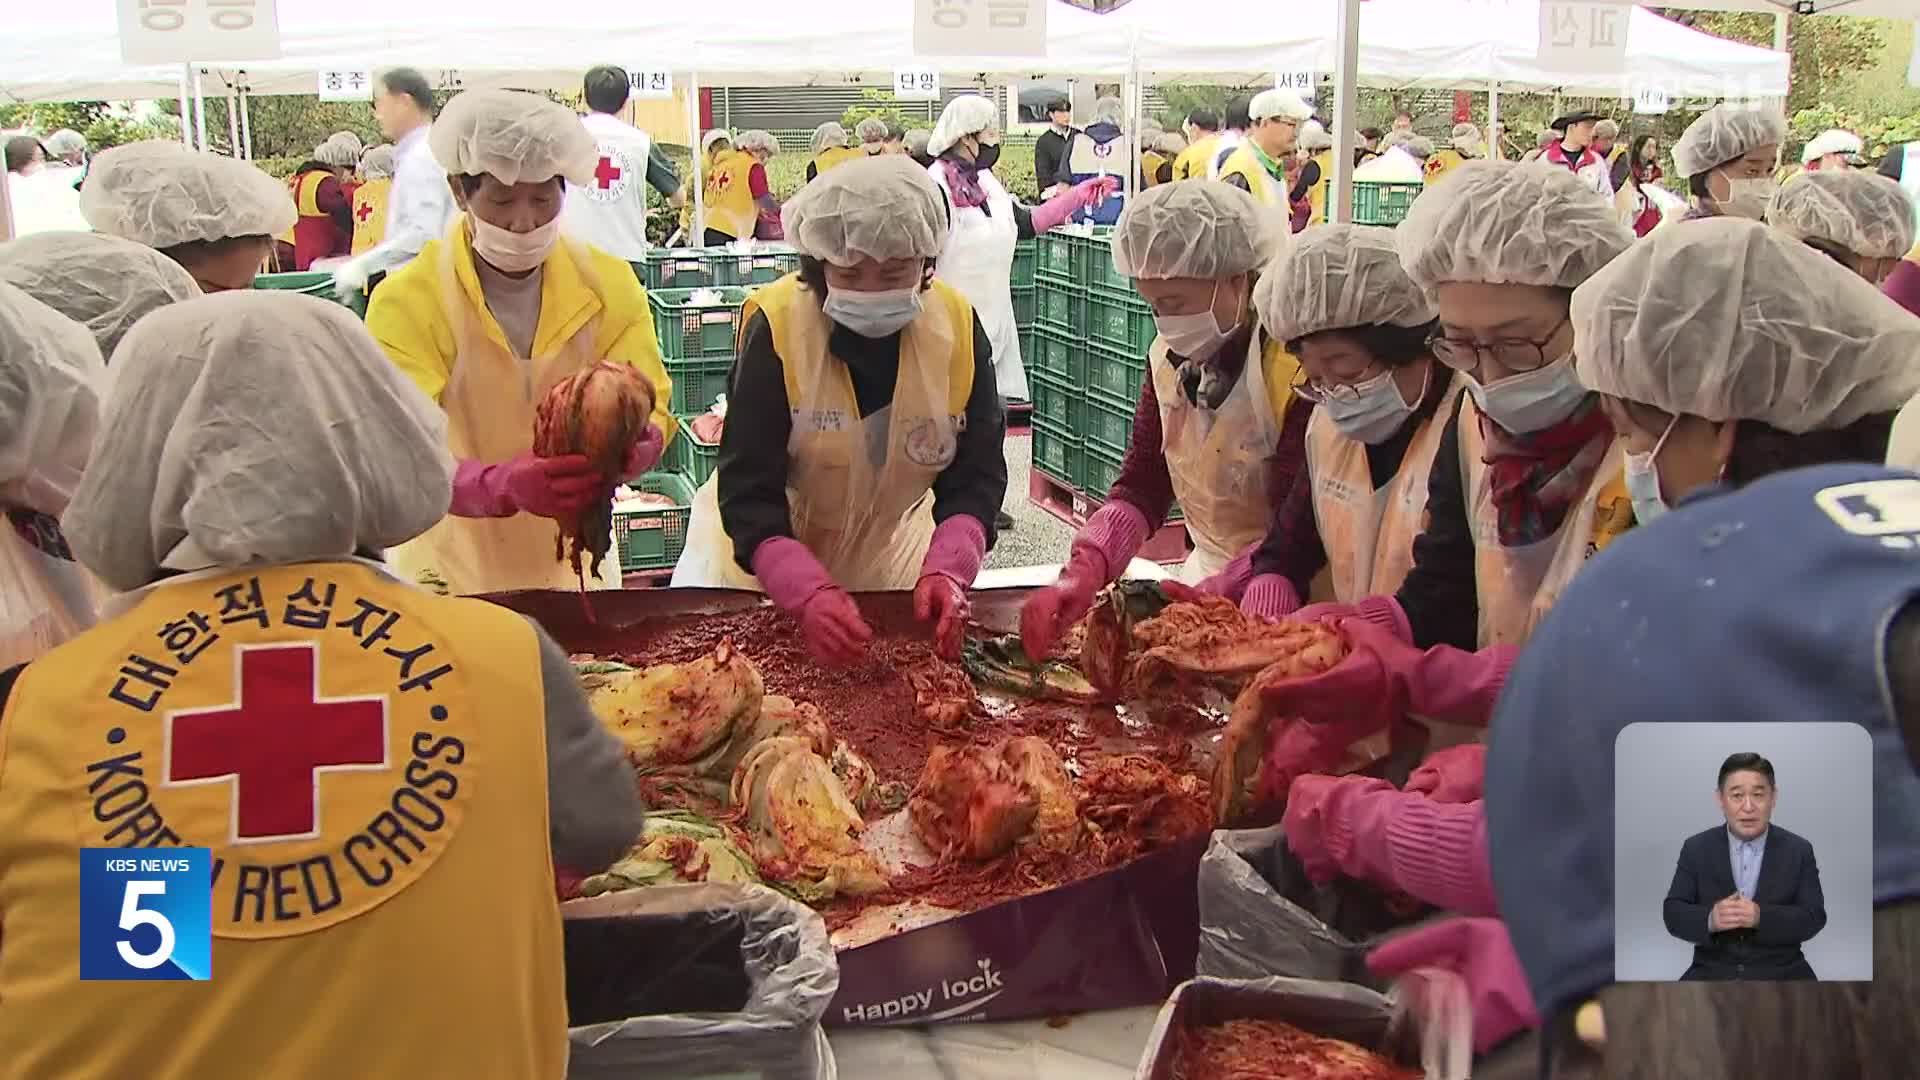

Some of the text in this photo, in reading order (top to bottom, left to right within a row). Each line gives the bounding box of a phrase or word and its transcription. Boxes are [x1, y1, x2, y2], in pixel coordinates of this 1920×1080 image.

[325, 71, 365, 91] 충주
[630, 71, 666, 91] 제천
[900, 72, 935, 91] 단양
[1279, 71, 1309, 89] 서원
[108, 575, 454, 713] 대한적십자사
[231, 854, 342, 922] RED
[343, 731, 465, 887] CROSS
[843, 957, 1003, 1023] Happy lock
